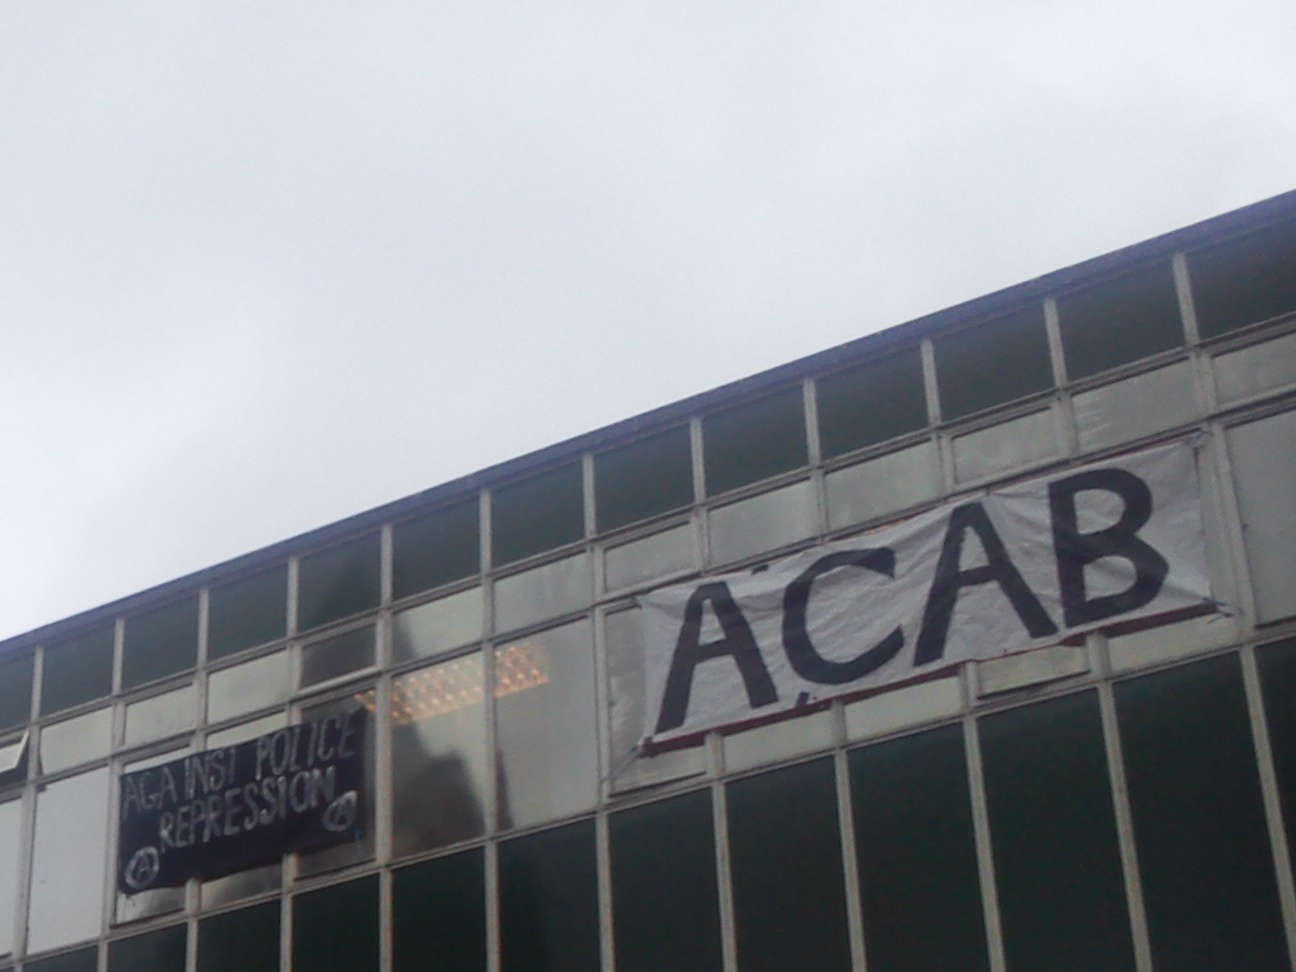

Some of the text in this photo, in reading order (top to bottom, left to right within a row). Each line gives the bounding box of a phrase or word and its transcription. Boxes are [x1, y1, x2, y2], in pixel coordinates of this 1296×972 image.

[655, 468, 1170, 734] ACAB
[123, 714, 356, 821] AGAINST POLICE
[158, 765, 336, 854] REPRESSION
